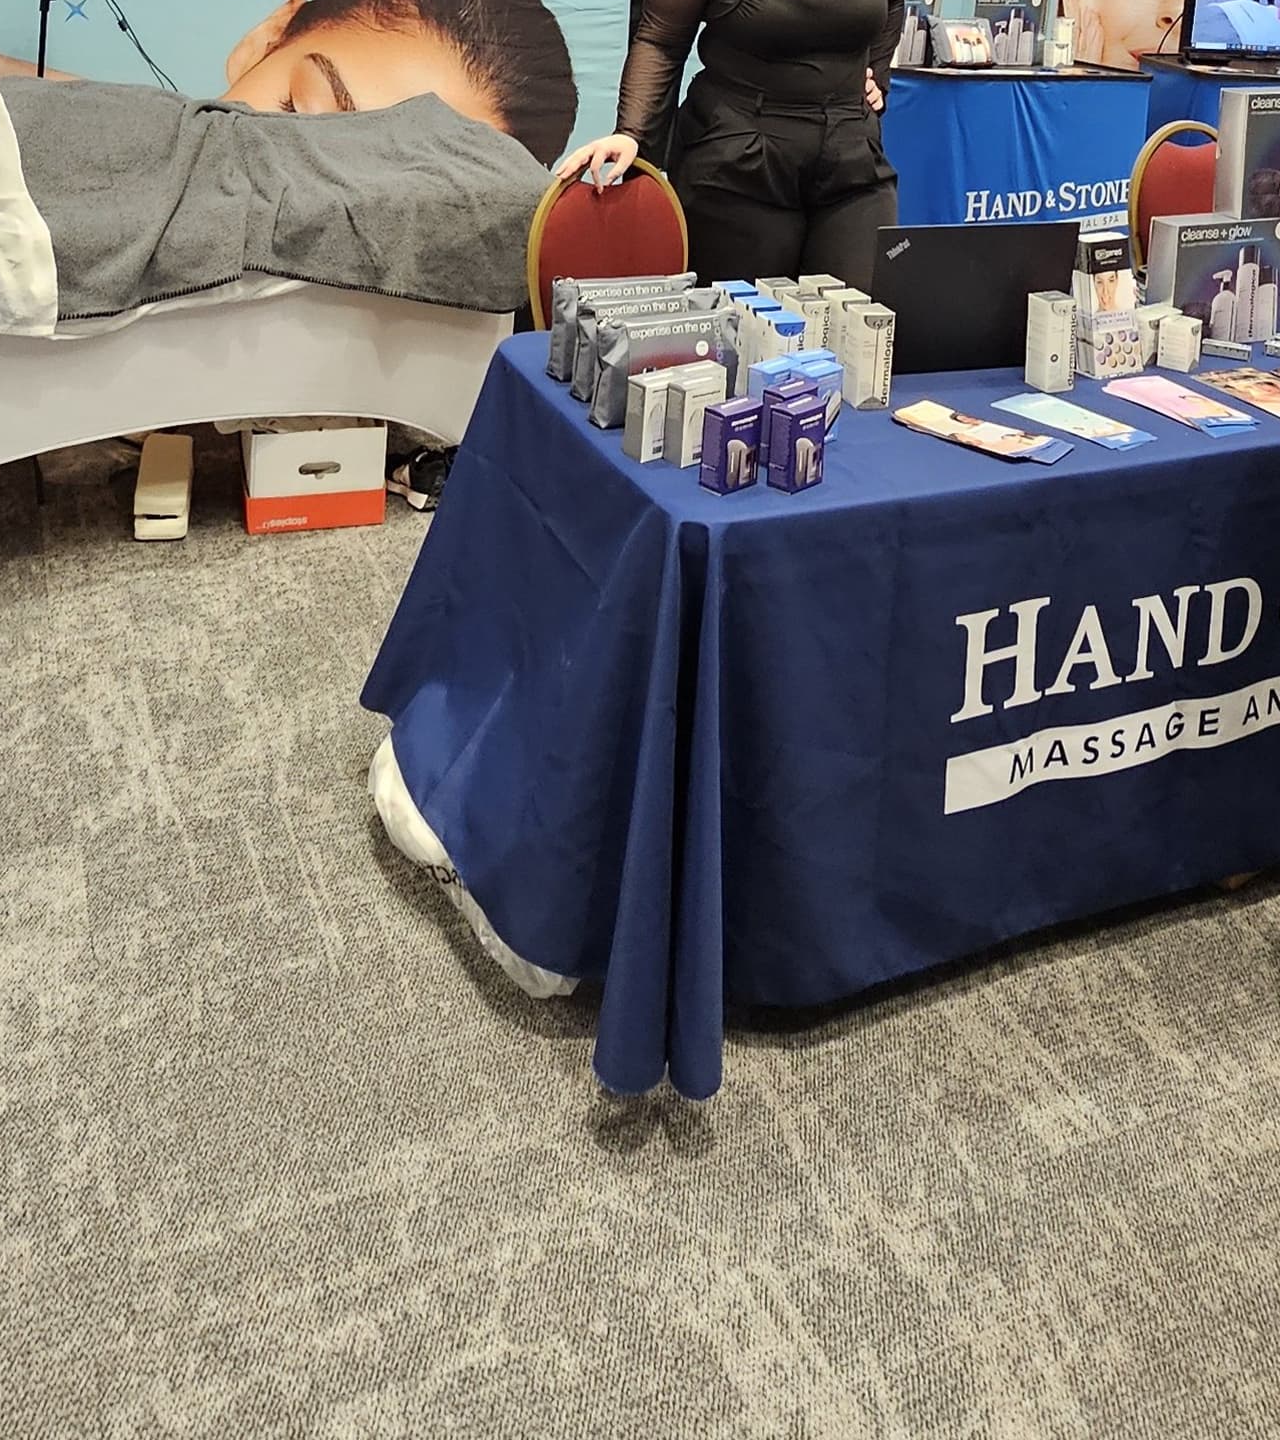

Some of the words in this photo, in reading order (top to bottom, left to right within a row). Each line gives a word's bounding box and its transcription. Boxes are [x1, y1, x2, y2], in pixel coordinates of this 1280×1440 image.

[964, 190, 1042, 222] HAND
[1045, 189, 1056, 209] &
[1181, 227, 1220, 242] cleanse
[1220, 230, 1228, 238] +
[1229, 225, 1253, 241] glow
[623, 287, 635, 297] on
[635, 285, 650, 295] the
[597, 305, 640, 318] expertise
[640, 303, 652, 313] on
[653, 301, 667, 311] the
[667, 301, 680, 313] go
[630, 326, 671, 340] expertise
[672, 324, 684, 334] on
[685, 322, 699, 333] the
[699, 321, 712, 334] go
[1067, 304, 1077, 386] dermalogica
[880, 318, 894, 406] dermalogica
[950, 576, 1263, 724] HAND
[1009, 707, 1221, 785] MASSAGE
